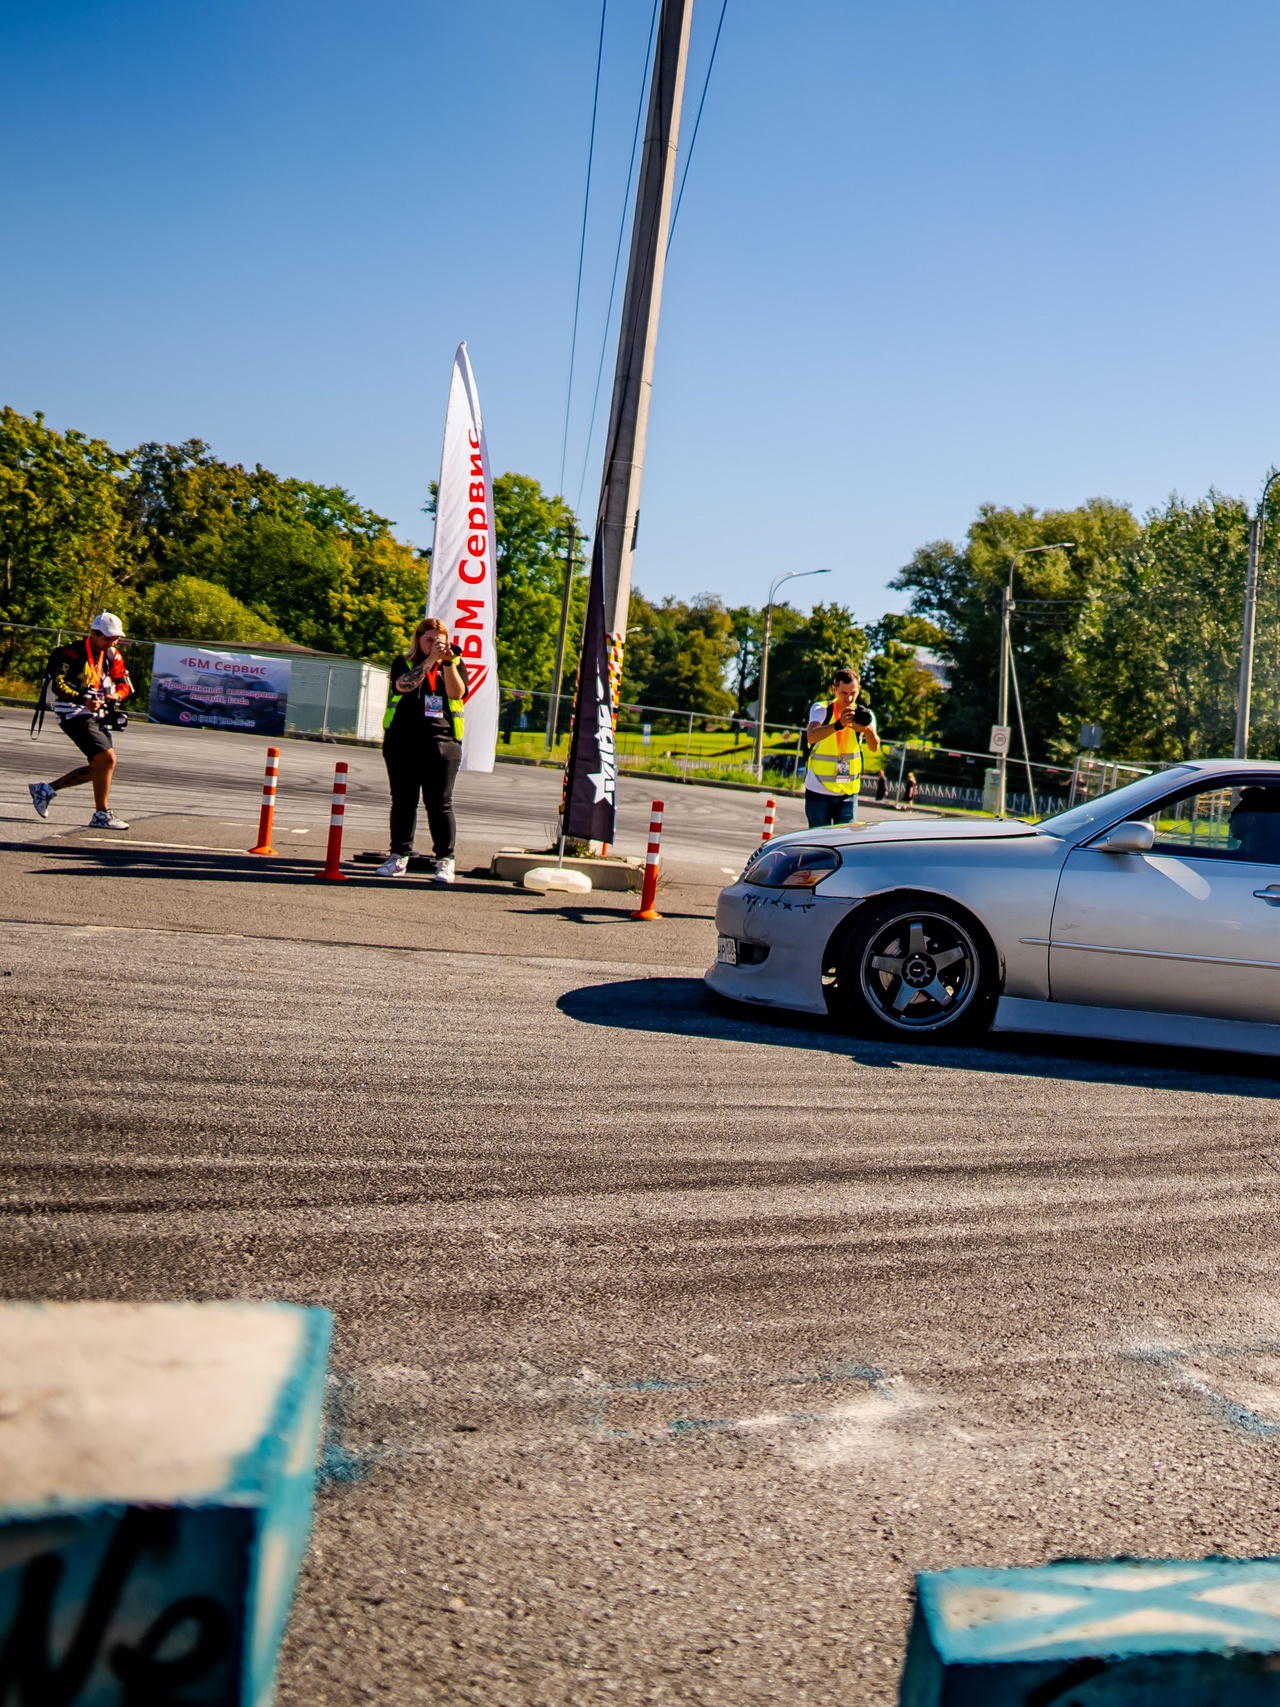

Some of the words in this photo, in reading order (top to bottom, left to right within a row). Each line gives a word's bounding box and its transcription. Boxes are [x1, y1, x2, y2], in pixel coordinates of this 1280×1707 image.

[454, 599, 485, 659] БМ
[188, 657, 210, 669] БМ
[214, 661, 267, 675] Сервис
[163, 680, 224, 694] Профильный
